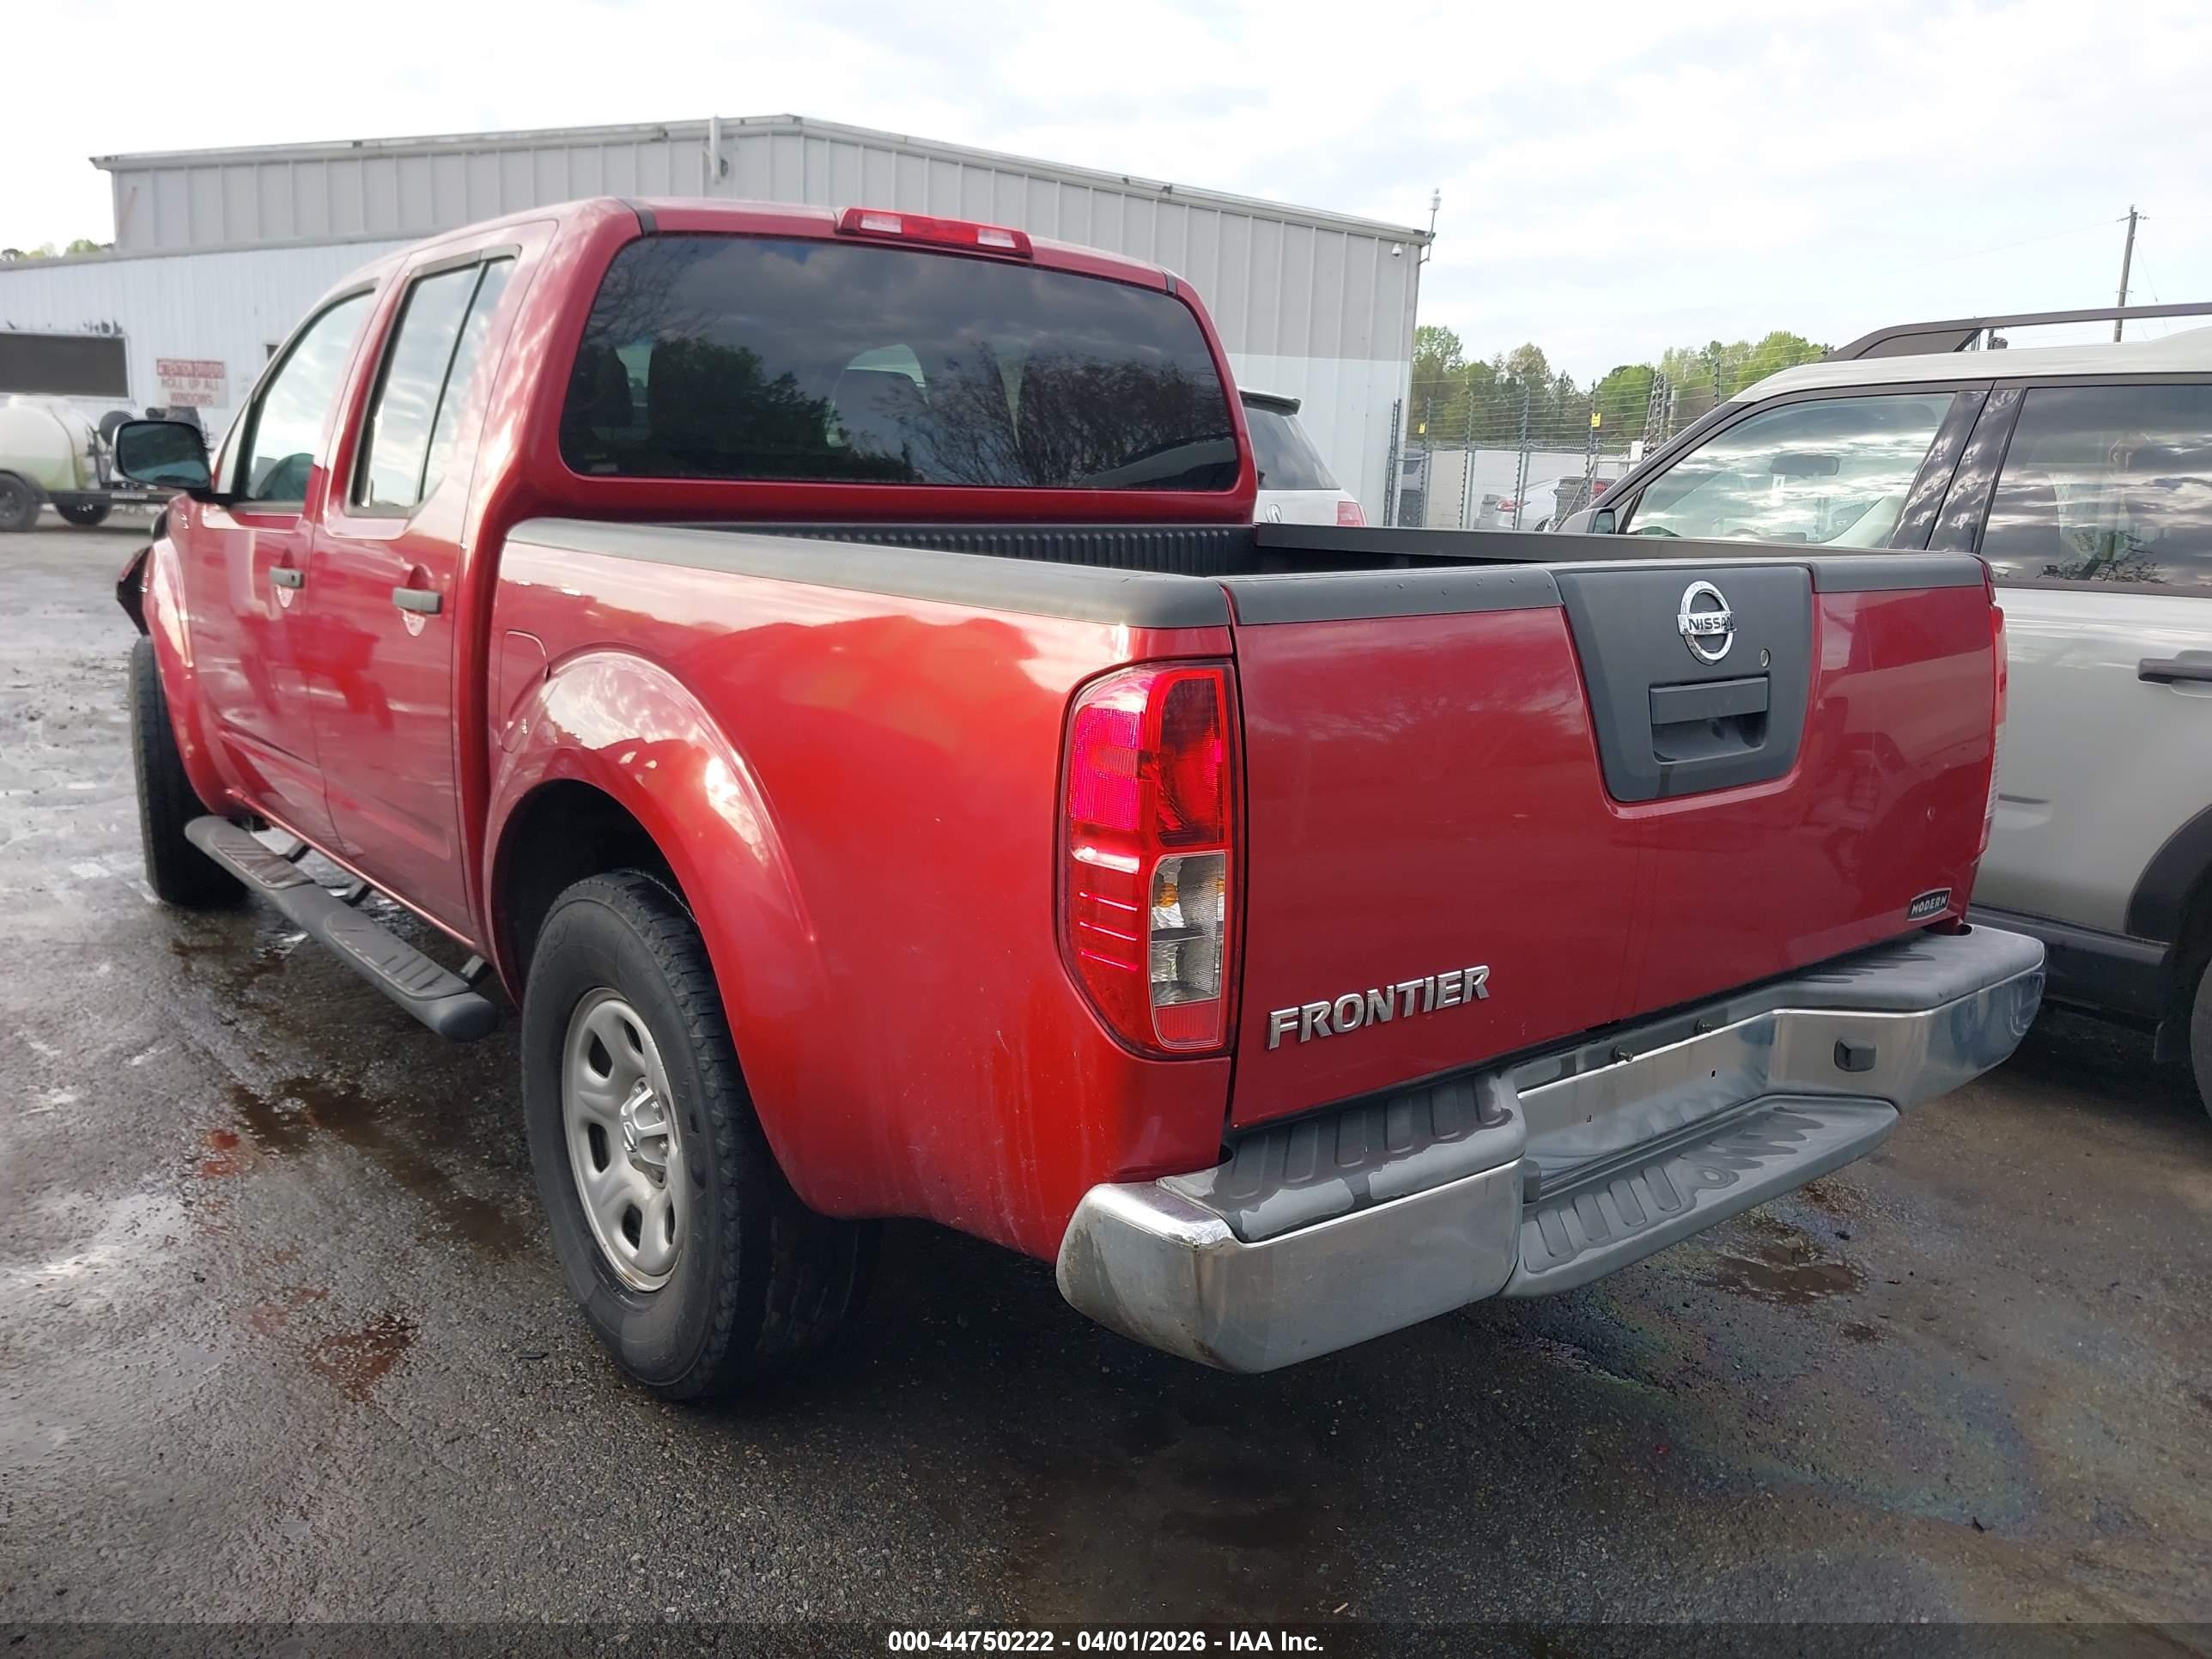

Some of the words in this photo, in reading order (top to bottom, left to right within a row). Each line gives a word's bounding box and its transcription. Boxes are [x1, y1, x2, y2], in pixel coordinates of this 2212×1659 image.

[188, 378, 201, 391] UP
[1688, 616, 1735, 632] NISSAN
[1911, 894, 1948, 915] MODERN
[1268, 964, 1491, 1050] FRONTIER
